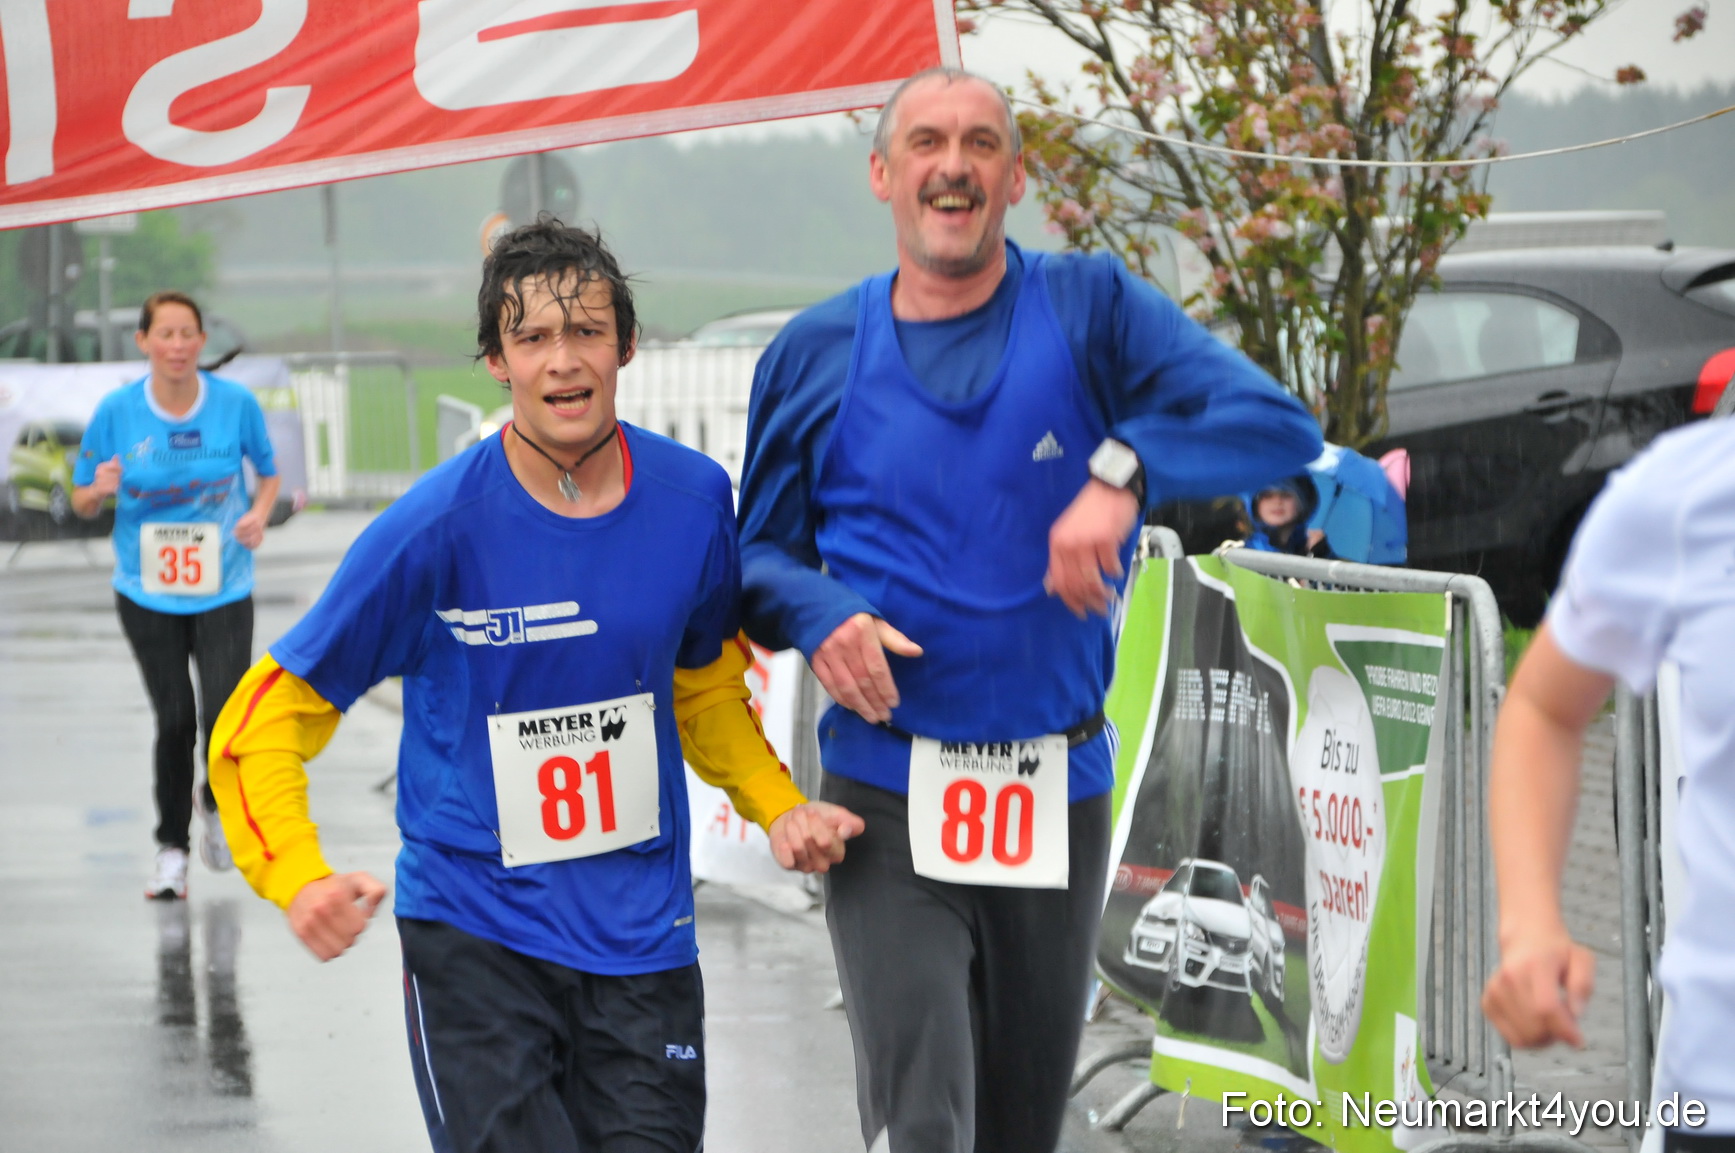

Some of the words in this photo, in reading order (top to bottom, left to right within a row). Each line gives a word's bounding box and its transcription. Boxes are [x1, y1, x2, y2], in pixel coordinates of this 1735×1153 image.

[158, 546, 202, 586] 35
[518, 713, 594, 737] MEYER
[520, 731, 596, 751] WERBUNG
[940, 740, 1013, 757] MEYER
[1321, 728, 1342, 772] Bis
[1344, 742, 1360, 776] zu
[939, 757, 1013, 775] WERBUNG
[537, 749, 617, 841] 81
[940, 778, 1035, 868] 80
[665, 1044, 698, 1060] FILA
